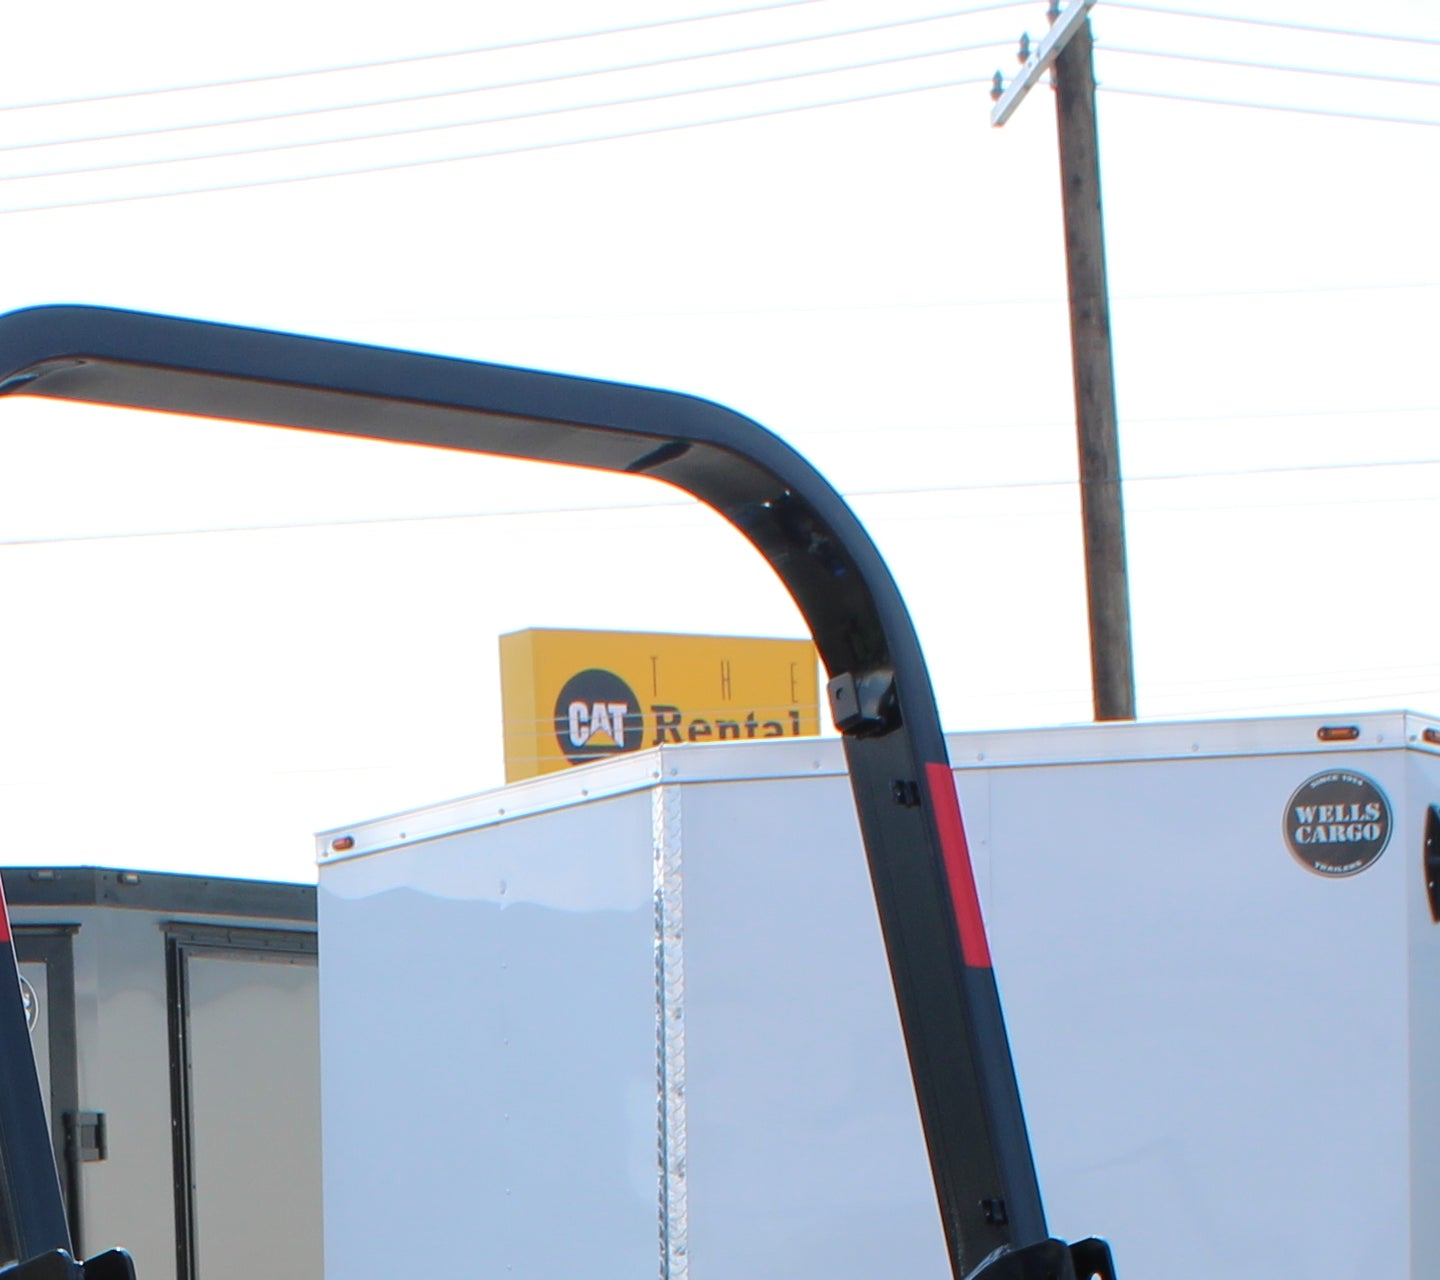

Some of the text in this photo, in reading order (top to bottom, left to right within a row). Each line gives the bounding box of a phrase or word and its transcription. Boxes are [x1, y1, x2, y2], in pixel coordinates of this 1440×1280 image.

[568, 701, 628, 748] CAT
[651, 705, 801, 746] Rental
[1295, 803, 1381, 824] WELLS
[1295, 823, 1381, 844] CARGO
